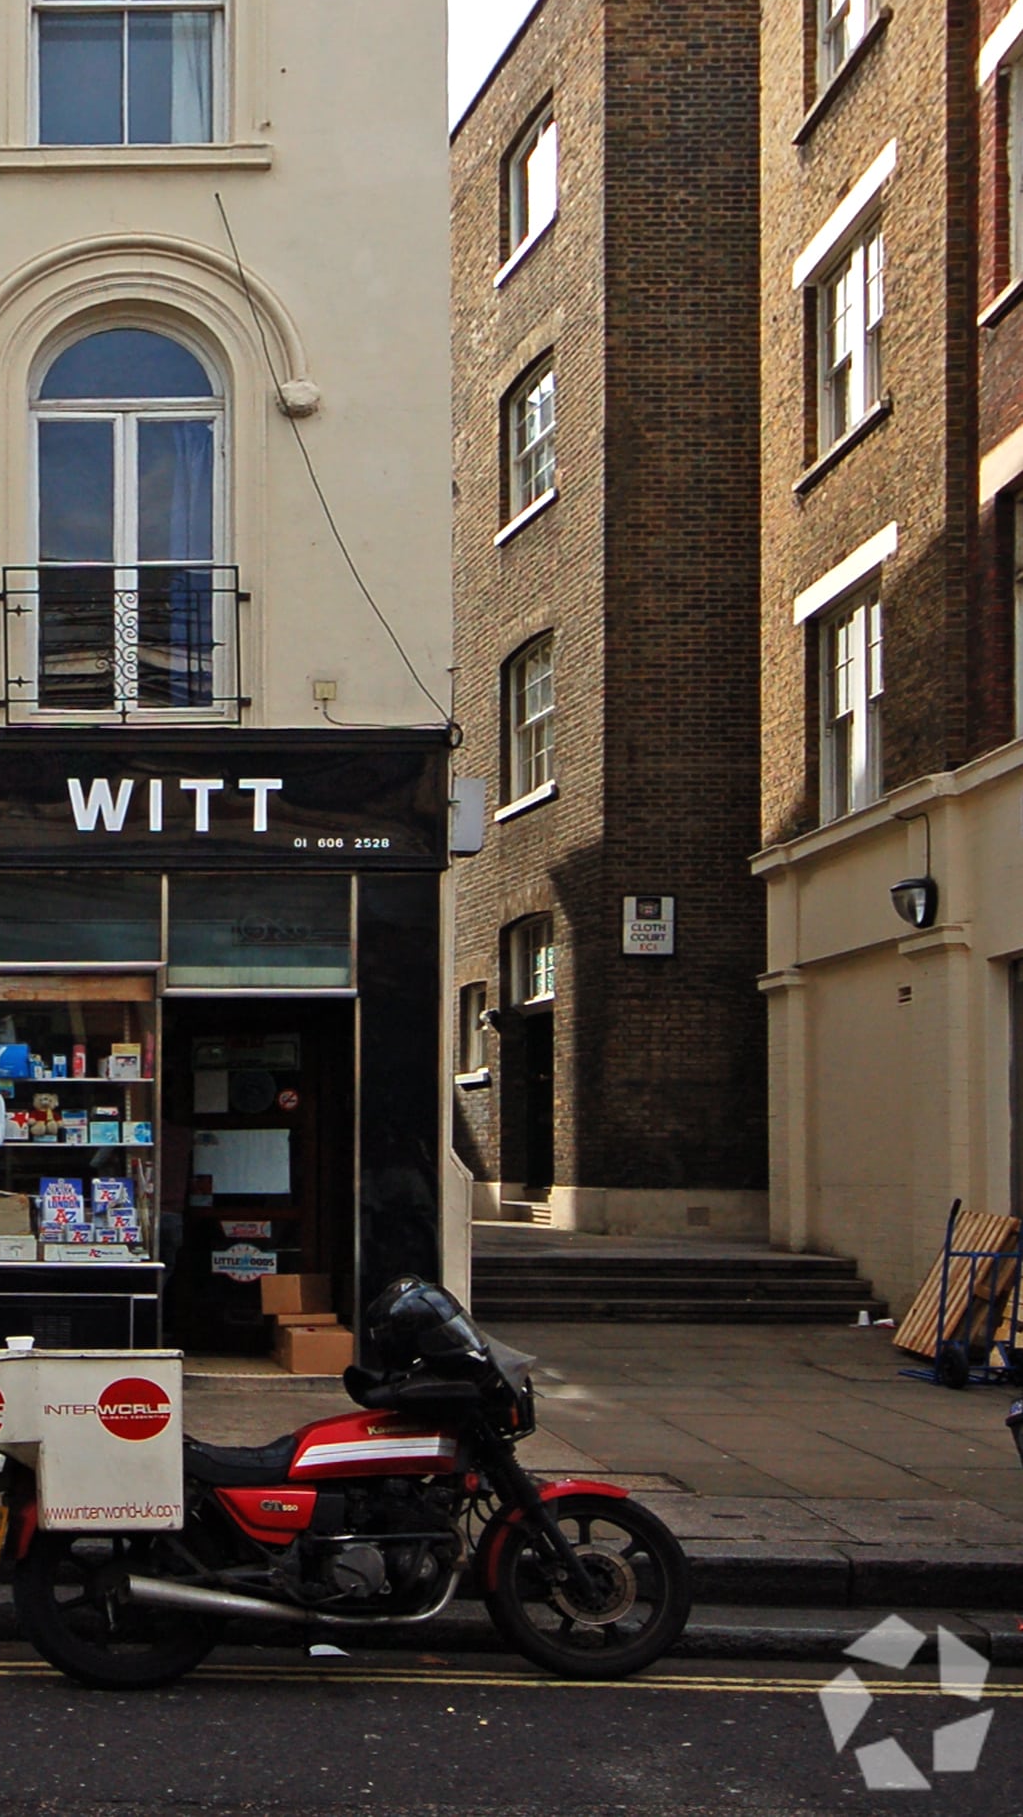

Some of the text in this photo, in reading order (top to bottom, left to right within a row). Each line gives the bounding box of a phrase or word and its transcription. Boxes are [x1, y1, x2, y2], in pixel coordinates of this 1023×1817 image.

[67, 778, 283, 832] WITT
[293, 838, 390, 849] 01 606 2528
[631, 923, 666, 932] CLOTH
[630, 933, 666, 942] COURT
[45, 1502, 181, 1521] www.interworld-uk.com
